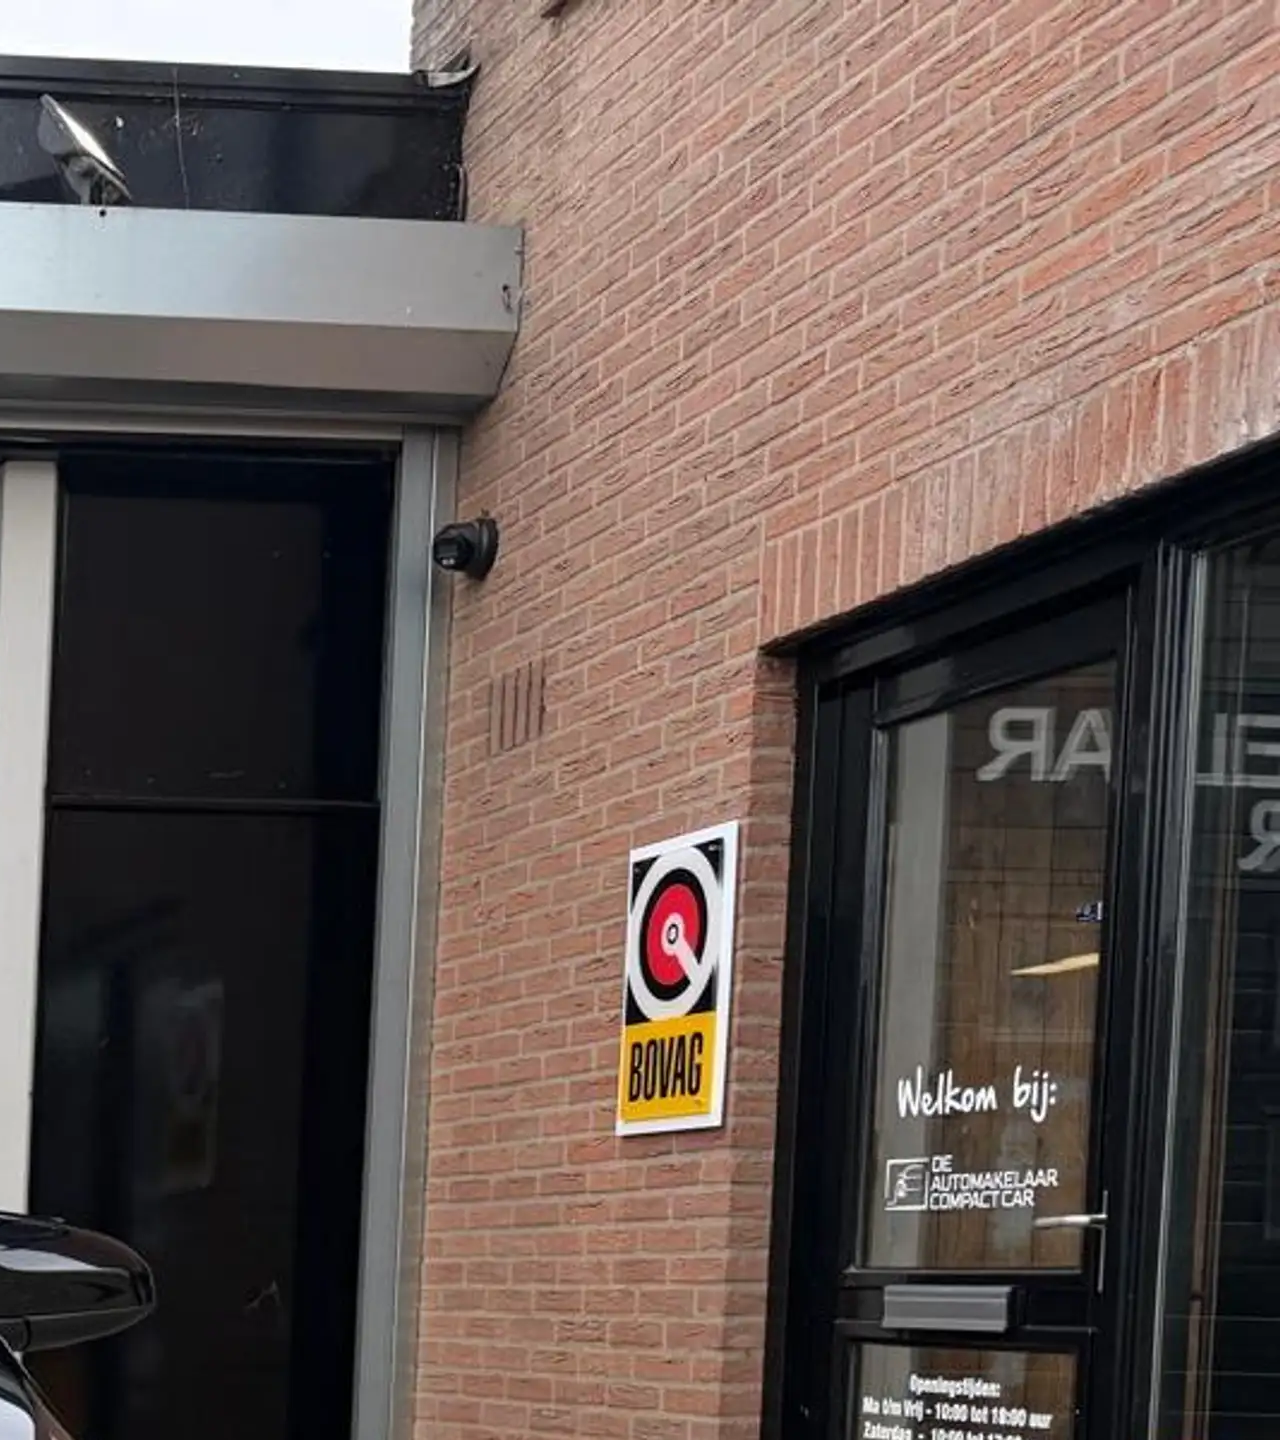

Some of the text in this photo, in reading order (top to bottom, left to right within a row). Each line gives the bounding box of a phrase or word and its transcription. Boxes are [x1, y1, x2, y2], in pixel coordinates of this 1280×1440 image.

[628, 1032, 703, 1102] BOVAG
[897, 1065, 1057, 1122] Welkom bij:
[931, 1154, 953, 1173] DE
[930, 1168, 1059, 1191] AUTOMAKELAAR
[929, 1189, 1035, 1210] COMPACT CAR
[970, 1406, 989, 1424] tot
[1029, 1413, 1054, 1429] uur
